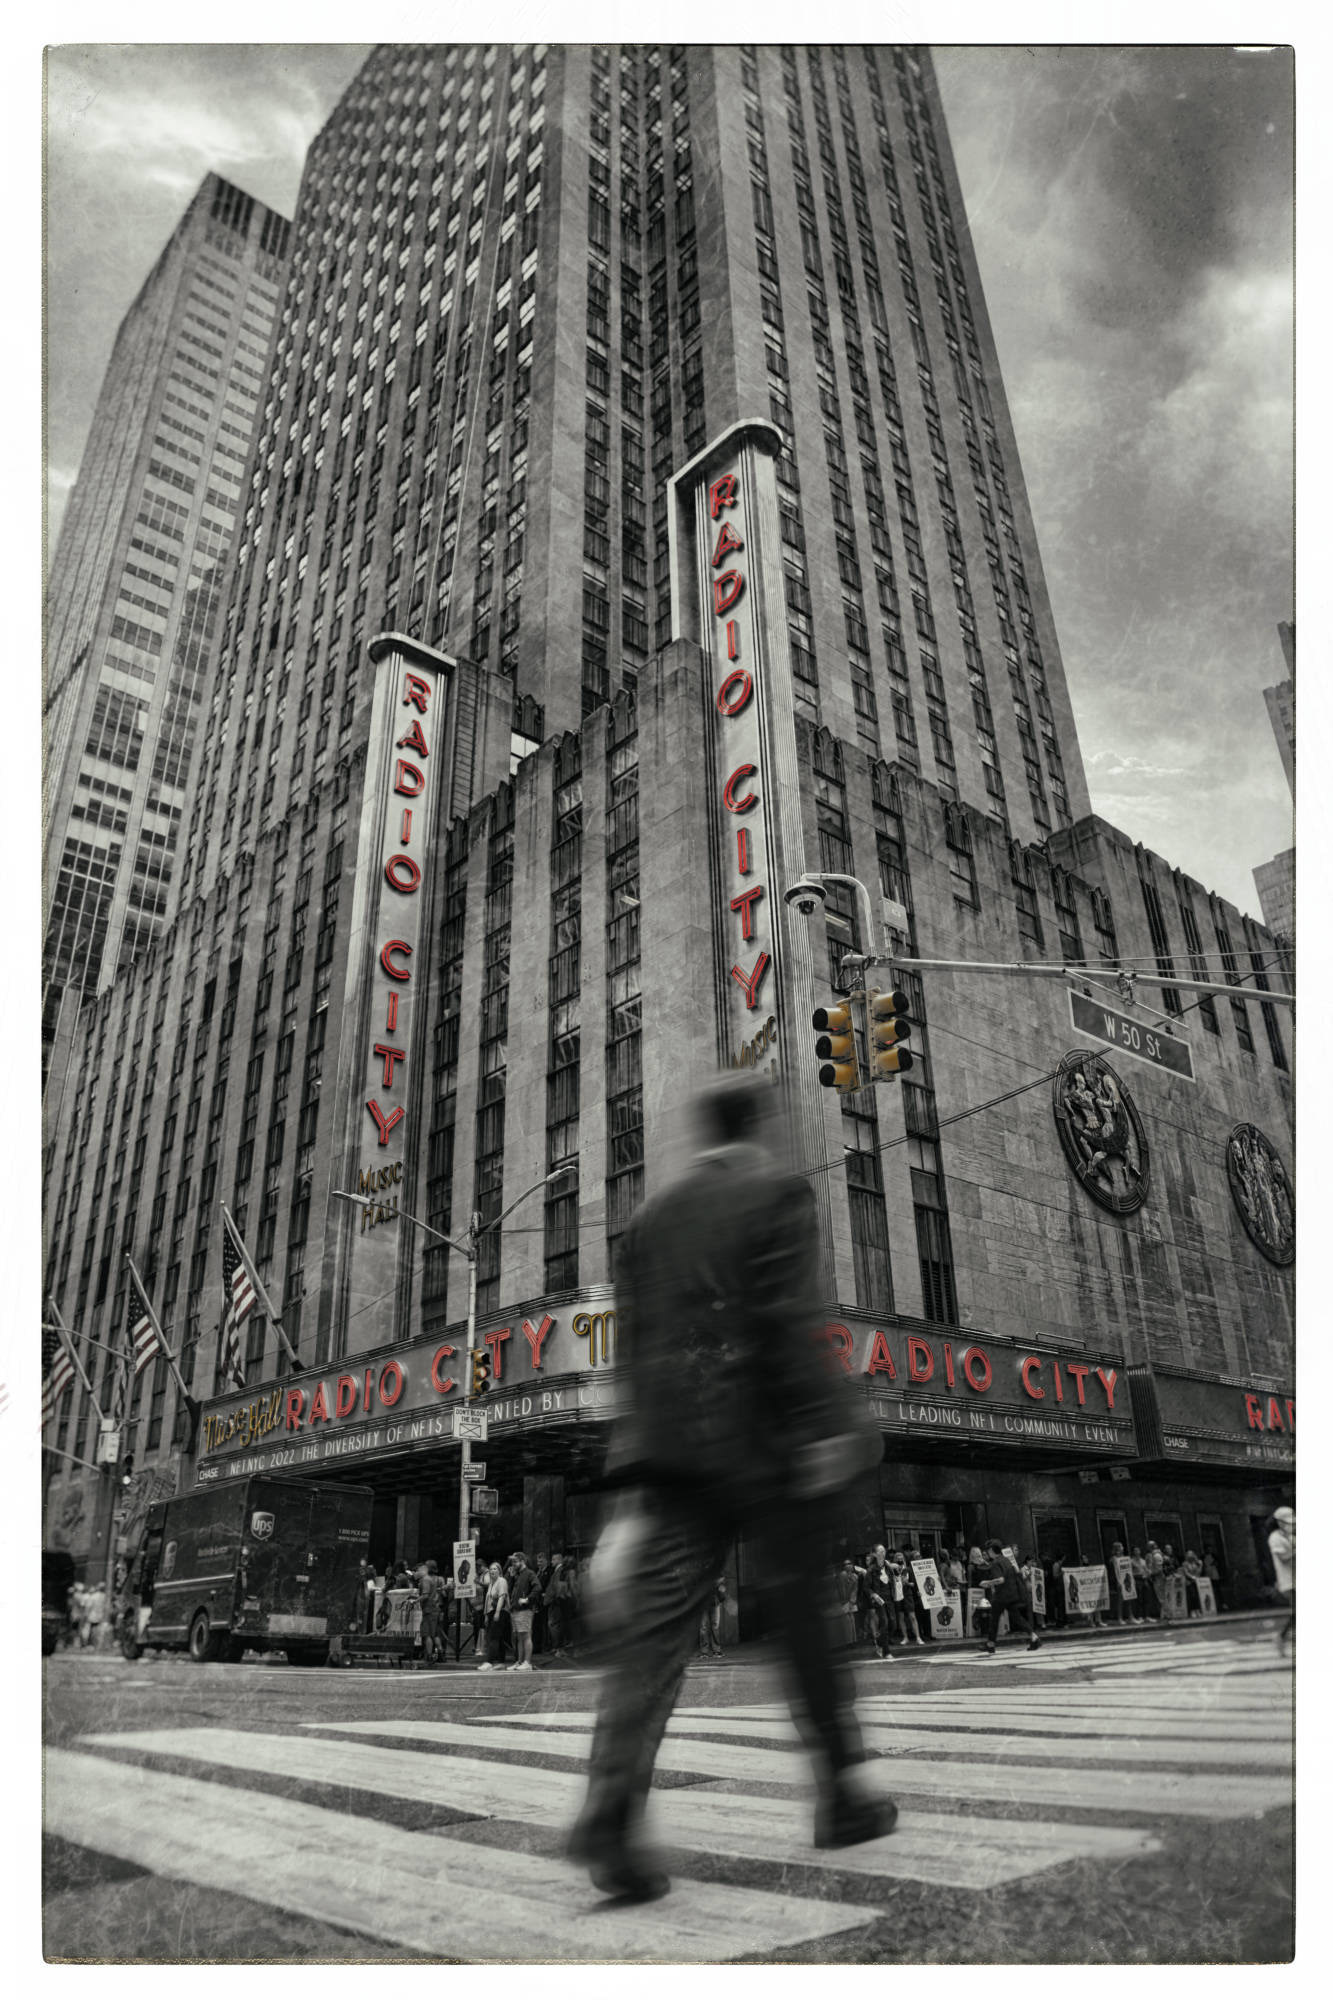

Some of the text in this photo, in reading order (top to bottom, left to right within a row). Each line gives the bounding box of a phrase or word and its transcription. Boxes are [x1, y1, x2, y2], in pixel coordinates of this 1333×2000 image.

[708, 473, 771, 1009] RADIO CITY
[367, 673, 432, 1145] RADIO CITY
[1104, 1013, 1162, 1060] W 50 St
[285, 1360, 404, 1431] RADIO
[430, 1315, 553, 1394] CTY
[824, 1321, 1118, 1409] RADIO CITY
[270, 1449, 295, 1468] 2022
[302, 1442, 320, 1460] THE
[324, 1430, 380, 1457] DIVERSITY
[387, 1427, 404, 1444] OF
[410, 1416, 443, 1439] NFTS
[542, 1391, 562, 1411] BY
[899, 1403, 961, 1426] LEADING
[970, 1411, 995, 1429] NFT
[1004, 1416, 1077, 1439] COMMUNITY
[1085, 1426, 1119, 1443] EVENT
[1163, 1436, 1190, 1449] CHASE
[199, 1466, 220, 1481] CHASE
